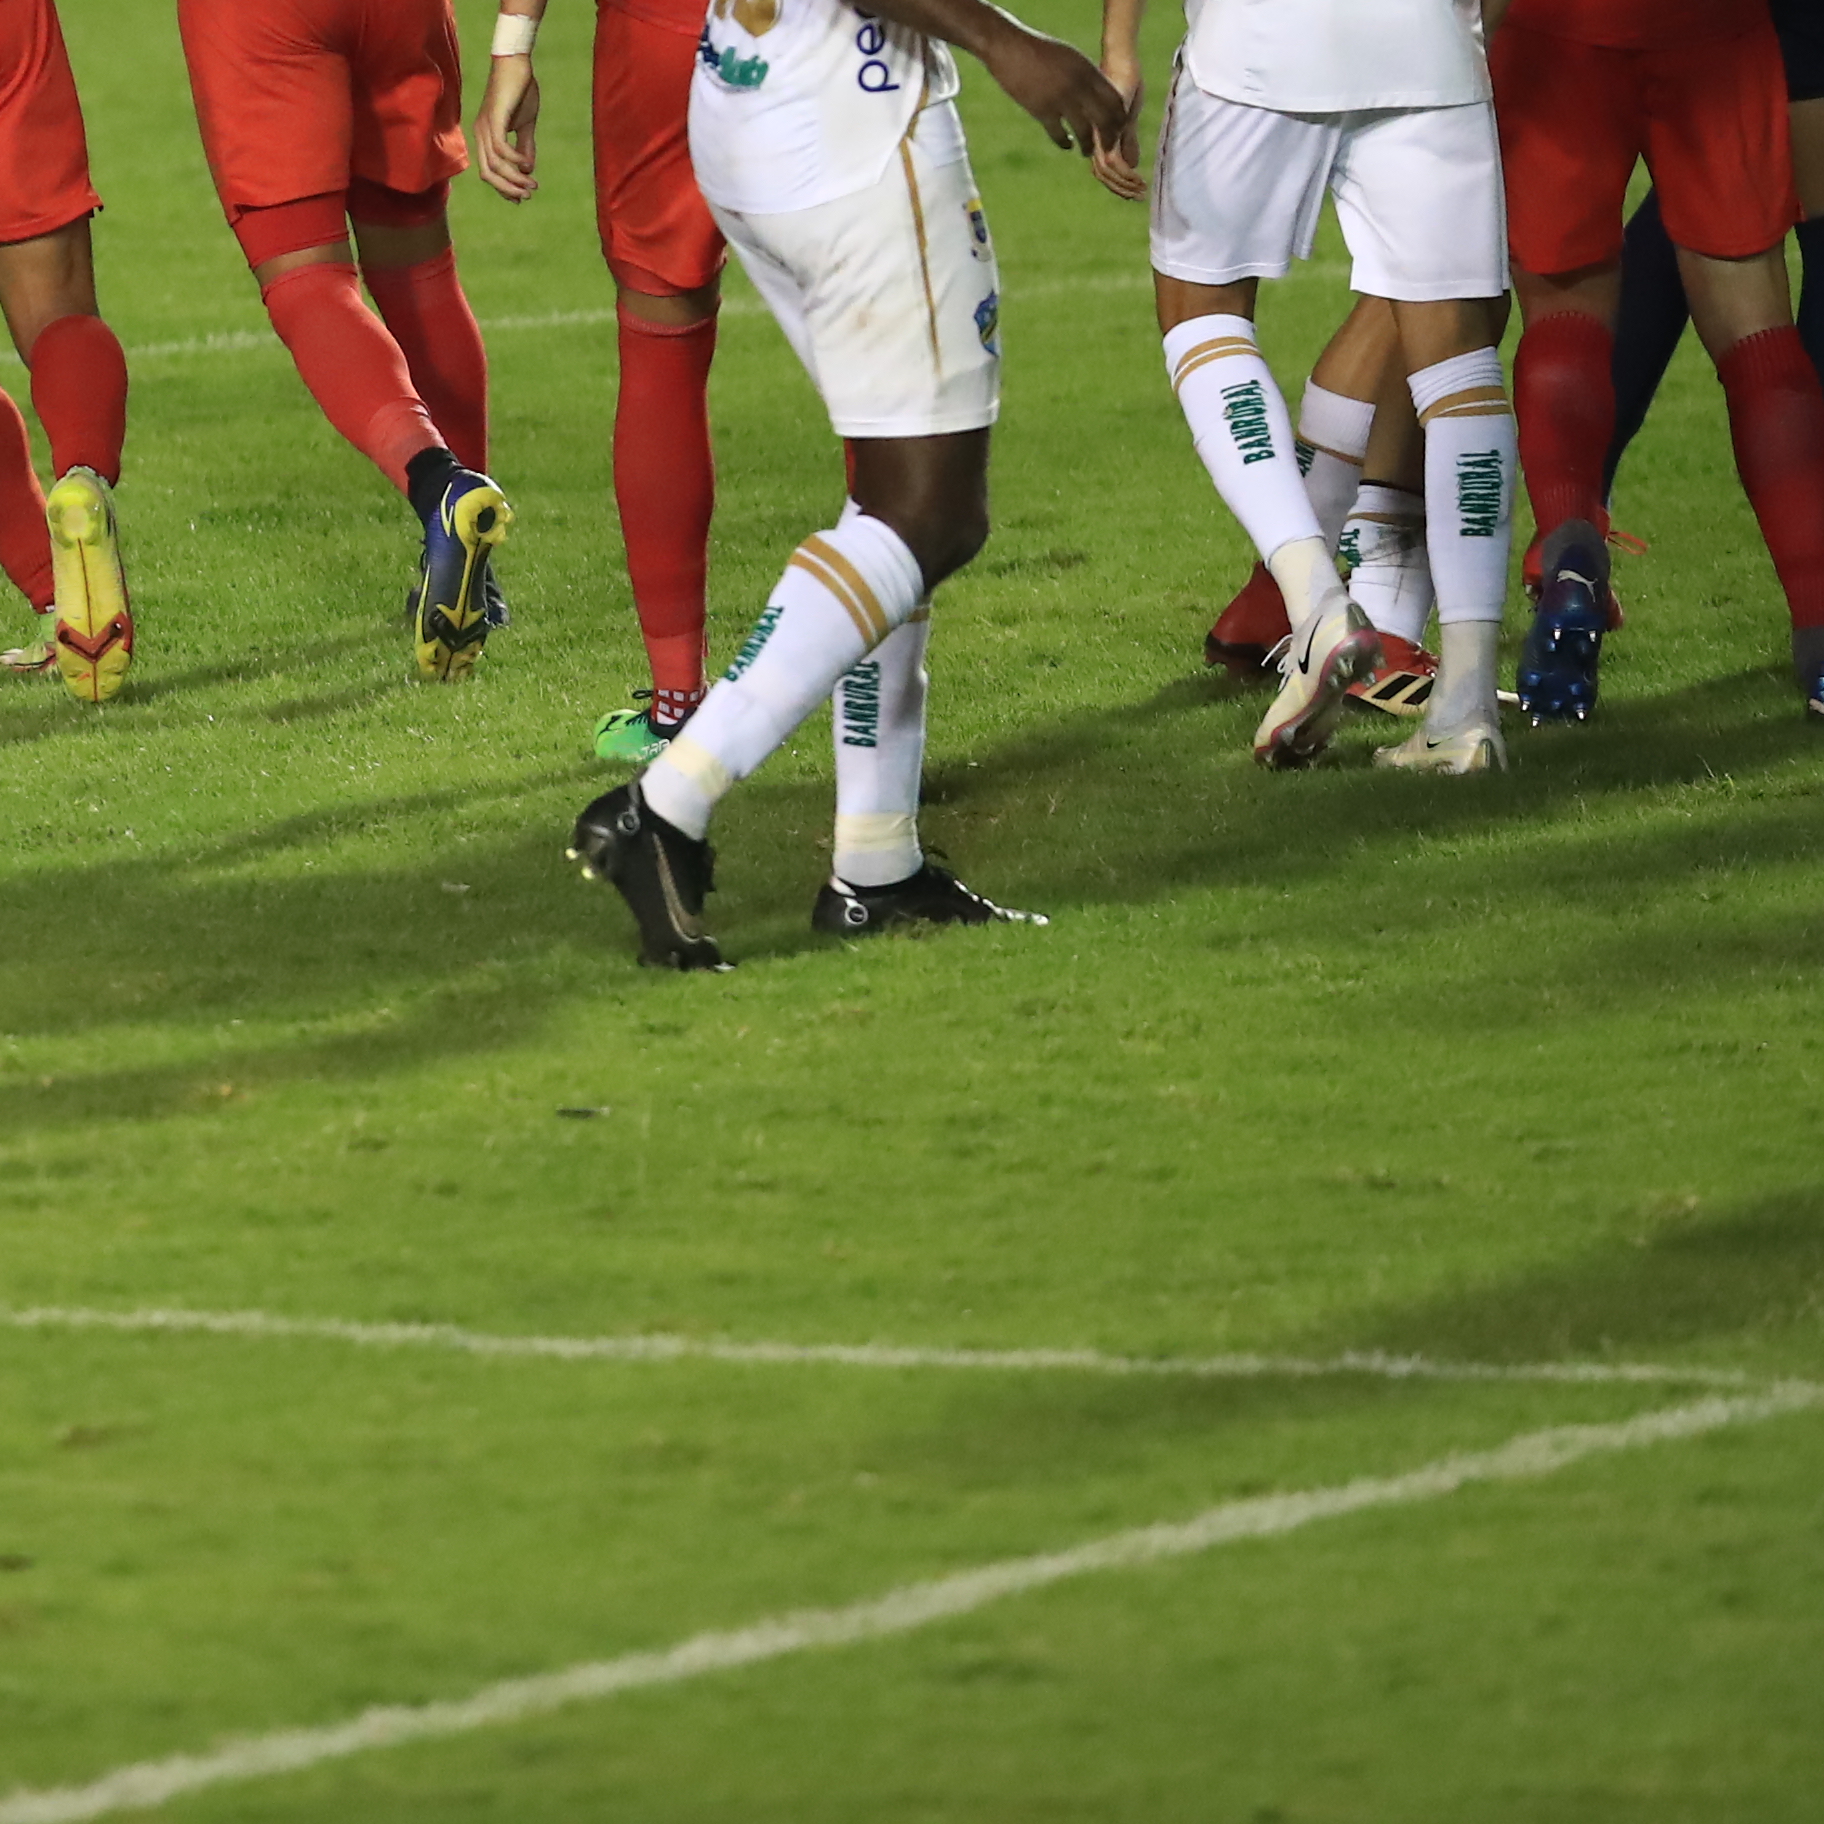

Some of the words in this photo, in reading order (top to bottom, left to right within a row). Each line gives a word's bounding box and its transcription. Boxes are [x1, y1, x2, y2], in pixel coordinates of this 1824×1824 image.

[1220, 379, 1276, 466] BANRURAL
[1456, 448, 1504, 537] BANRURAL
[842, 660, 881, 748] BANRURAL
